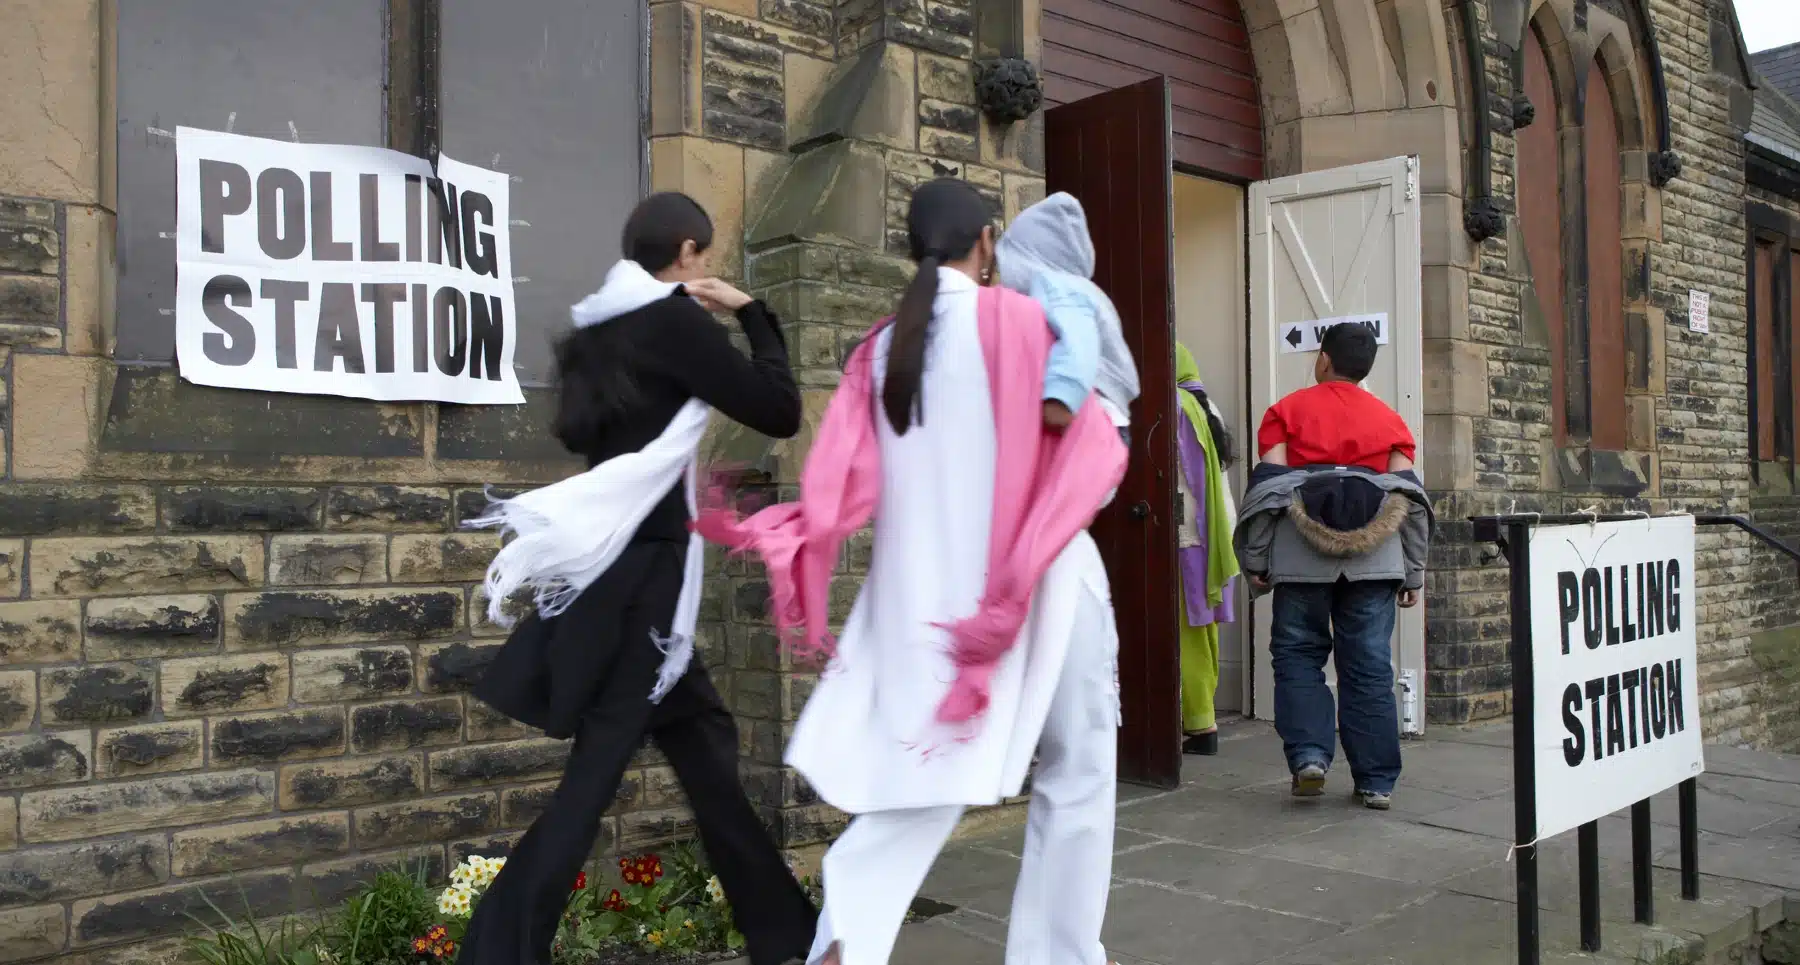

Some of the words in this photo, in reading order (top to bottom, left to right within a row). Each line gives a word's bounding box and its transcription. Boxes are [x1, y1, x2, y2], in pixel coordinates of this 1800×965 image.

[199, 158, 499, 279] POLLING
[202, 274, 503, 381] STATION
[1360, 320, 1380, 339] N
[1557, 558, 1681, 656] POLLING
[1561, 658, 1685, 768] STATION
